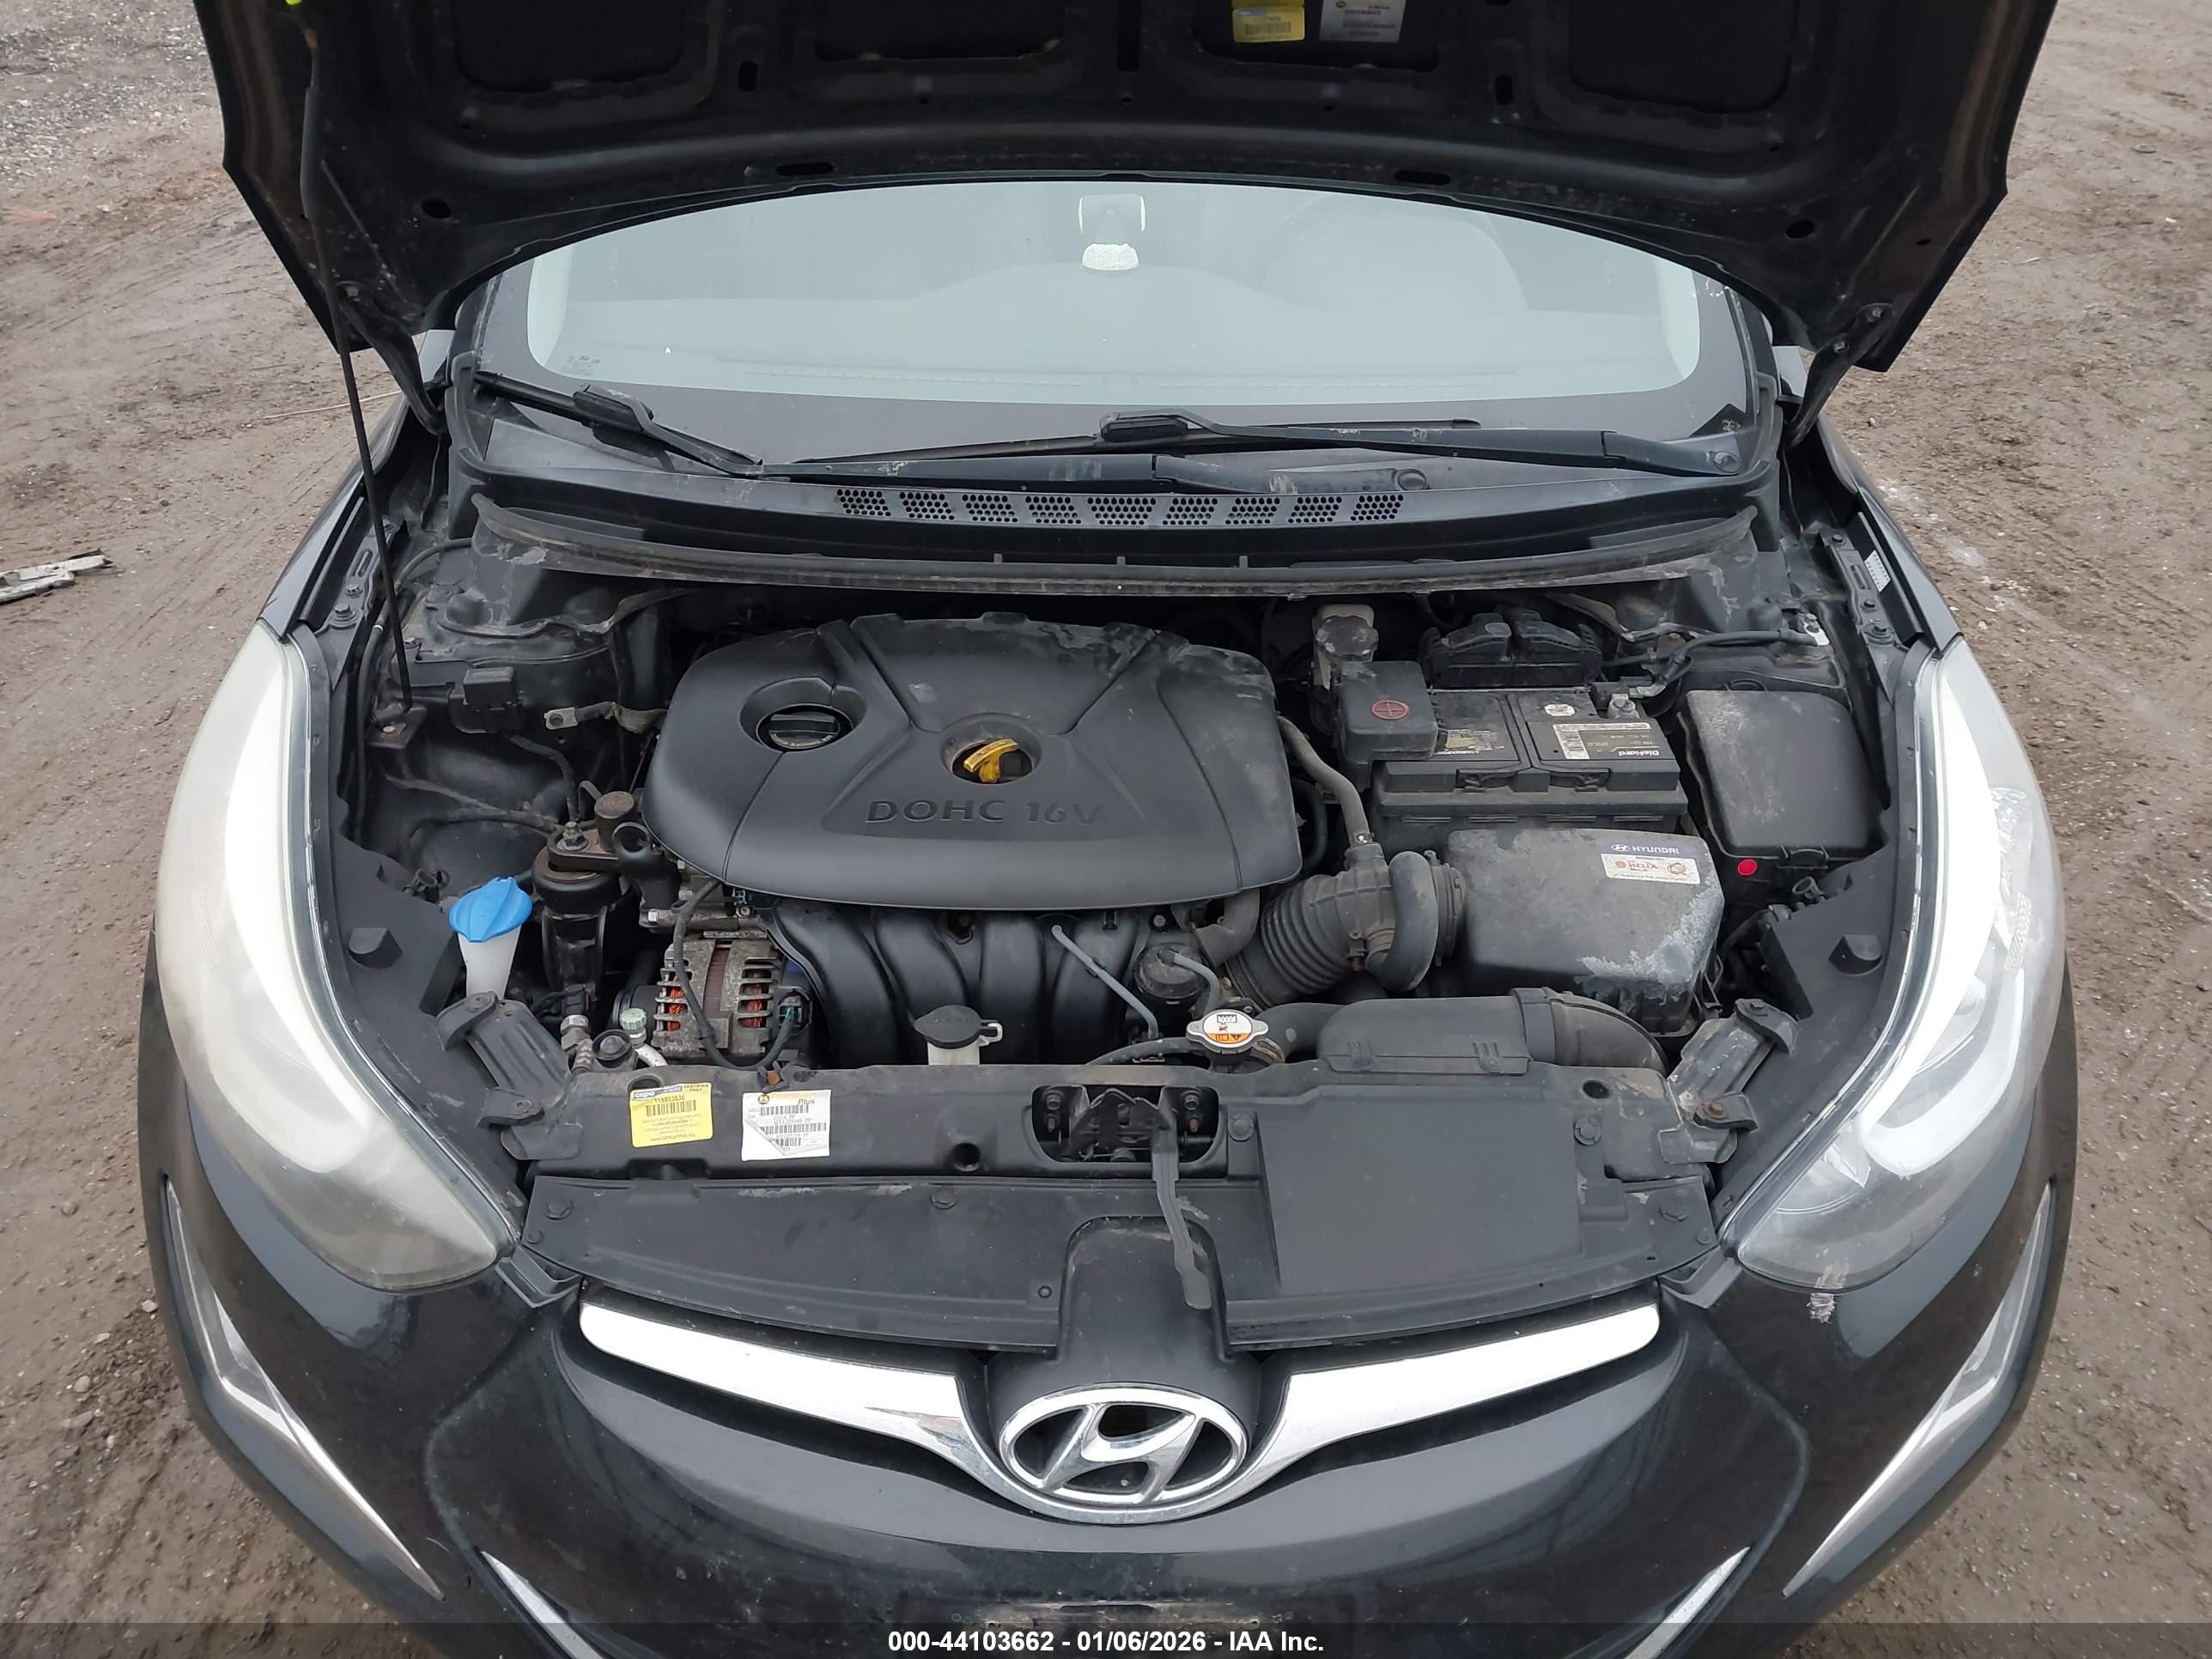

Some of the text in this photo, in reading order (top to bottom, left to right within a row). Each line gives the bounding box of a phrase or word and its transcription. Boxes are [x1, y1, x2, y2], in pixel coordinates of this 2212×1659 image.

[866, 799, 1104, 825] DOHC 16V
[1632, 846, 1680, 854] HYUNDAI
